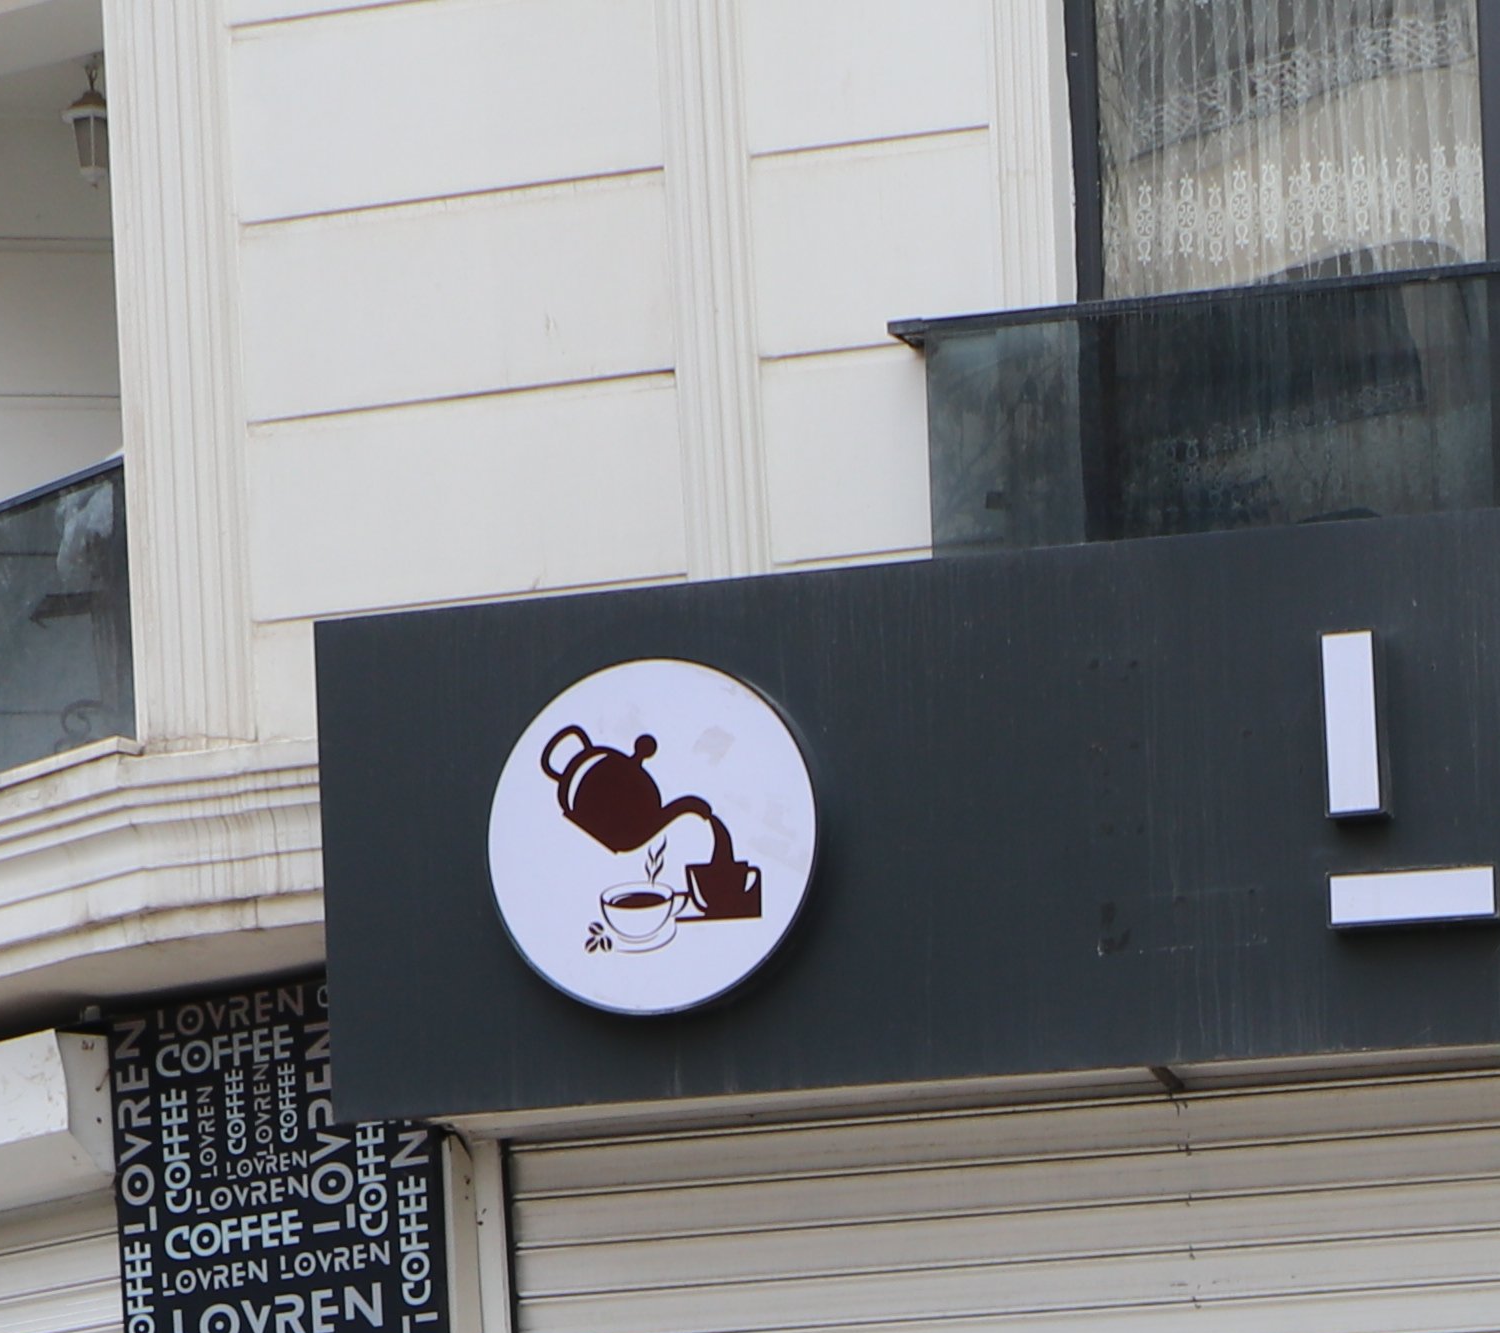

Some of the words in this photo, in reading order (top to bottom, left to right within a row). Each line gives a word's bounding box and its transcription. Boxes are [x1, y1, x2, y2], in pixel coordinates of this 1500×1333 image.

[156, 985, 304, 1041] LOVREN
[156, 1025, 294, 1077] COFFEE
[113, 1019, 158, 1235] LOVREN
[197, 1086, 218, 1179] LOVREN
[225, 1069, 247, 1155] COFFEE
[252, 1063, 274, 1158] LOVREN
[277, 1062, 299, 1143] COFFEE
[161, 1088, 193, 1213] COFFEE
[226, 1150, 308, 1181] LOVREN
[356, 1121, 389, 1236] COFFE
[164, 1209, 303, 1260] COFFEE
[196, 1174, 309, 1215] LOVREN
[161, 1258, 269, 1296] LOVREN
[280, 1241, 391, 1279] LOVREN
[397, 1175, 432, 1305] COFFEE
